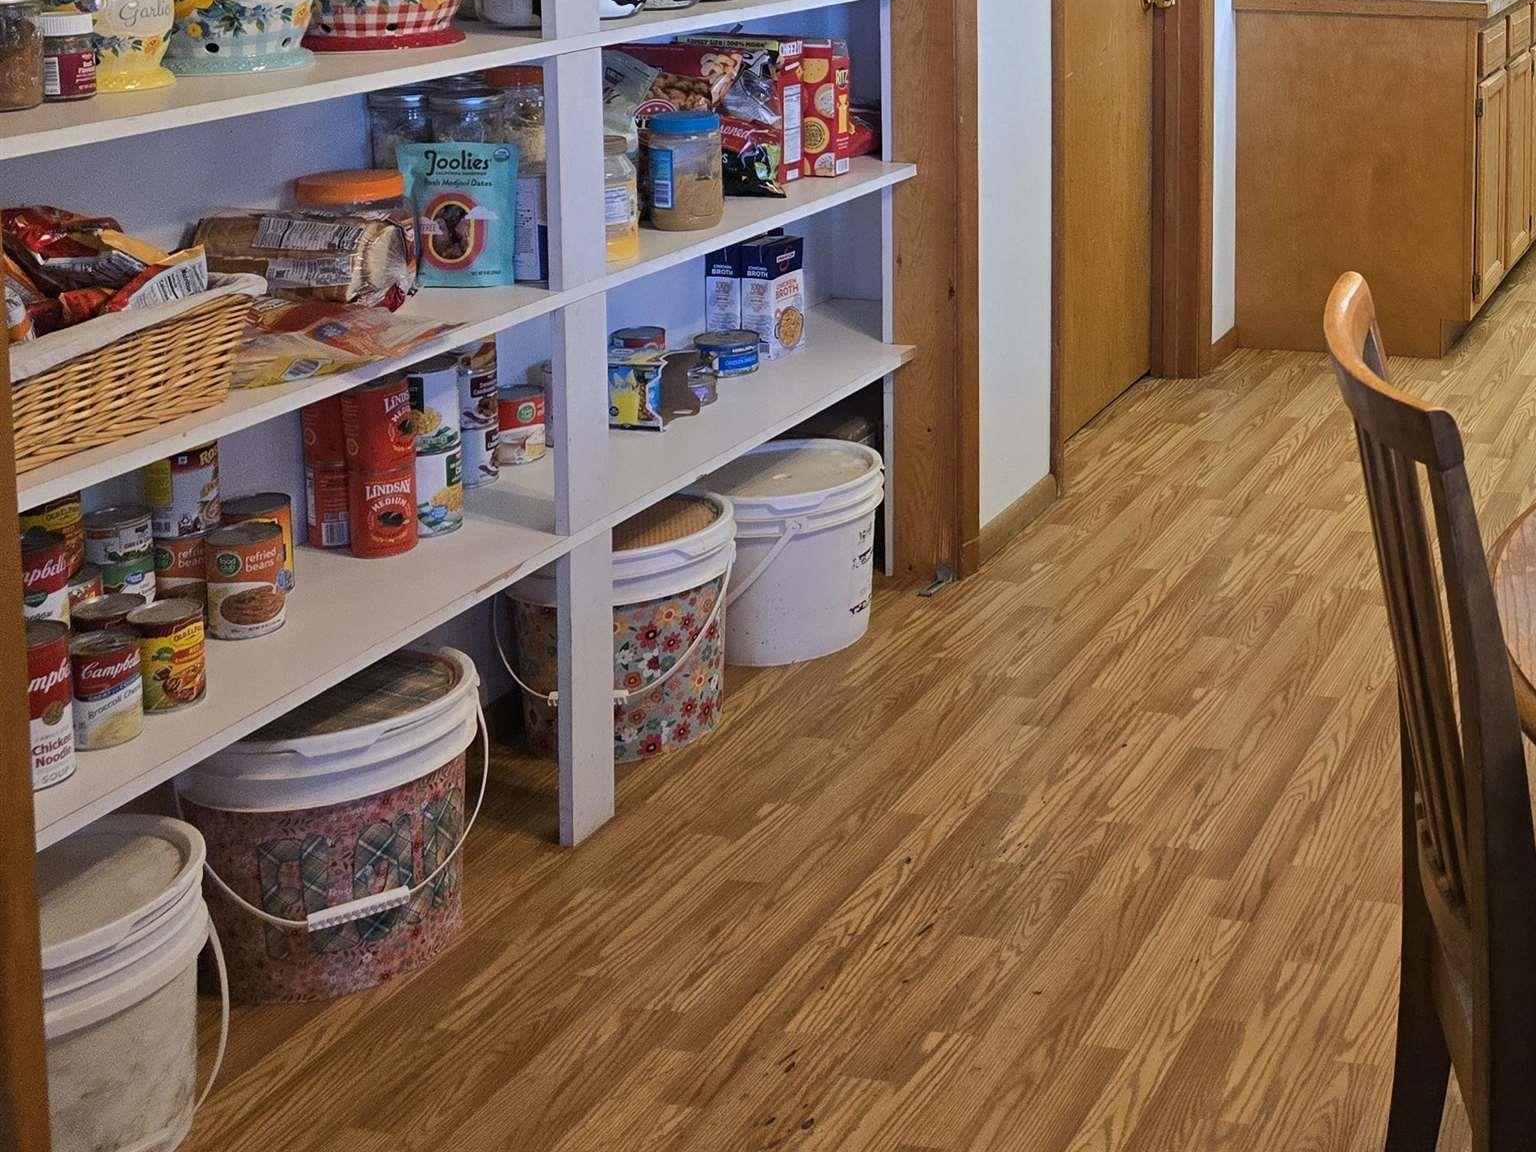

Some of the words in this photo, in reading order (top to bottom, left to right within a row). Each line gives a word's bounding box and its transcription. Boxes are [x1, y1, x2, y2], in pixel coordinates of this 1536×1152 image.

[424, 149, 490, 177] Joolies
[441, 178, 470, 189] Medjool
[470, 178, 493, 188] Dates
[711, 268, 734, 276] BROTH
[746, 270, 768, 278] BROTH
[775, 285, 799, 299] BROTH
[365, 478, 412, 501] LINDSAY
[371, 497, 408, 514] MEDIUM
[245, 546, 277, 564] refried
[245, 558, 275, 573] beans
[87, 696, 123, 721] Broccoli
[41, 766, 70, 785] SOUP
